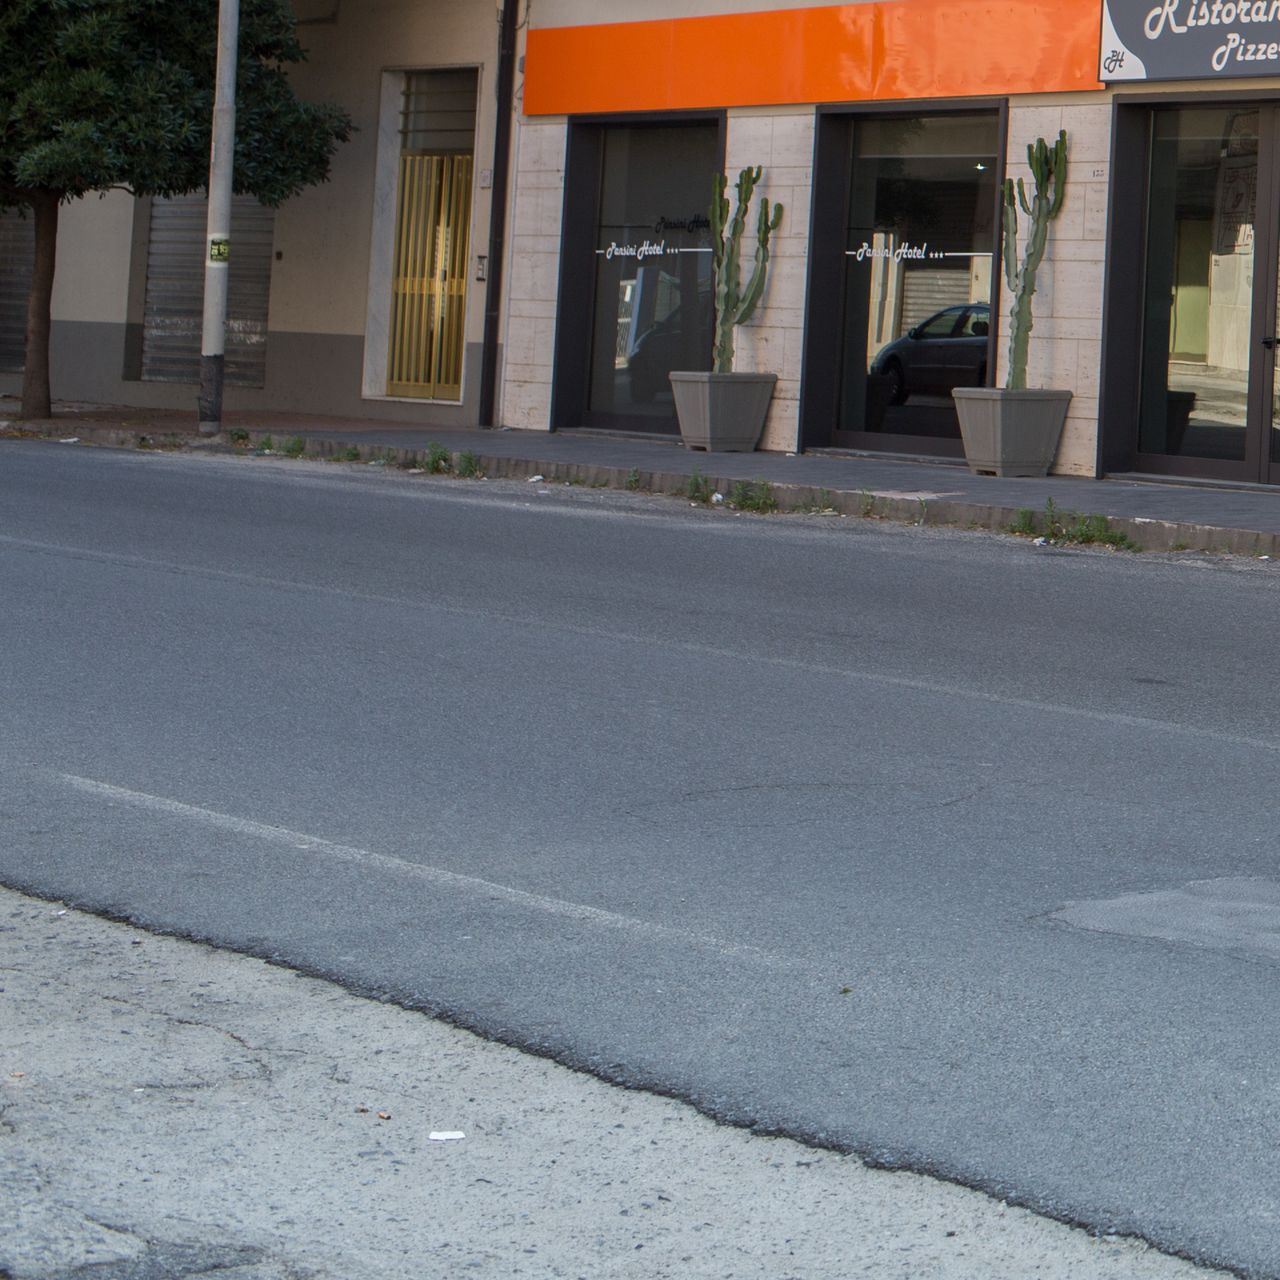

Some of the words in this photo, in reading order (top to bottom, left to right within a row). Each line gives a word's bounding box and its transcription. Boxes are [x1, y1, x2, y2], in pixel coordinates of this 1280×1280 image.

[606, 241, 637, 260] Pansini
[637, 240, 665, 261] Hotel
[856, 242, 893, 262] Pansini
[894, 242, 927, 263] Hotel
